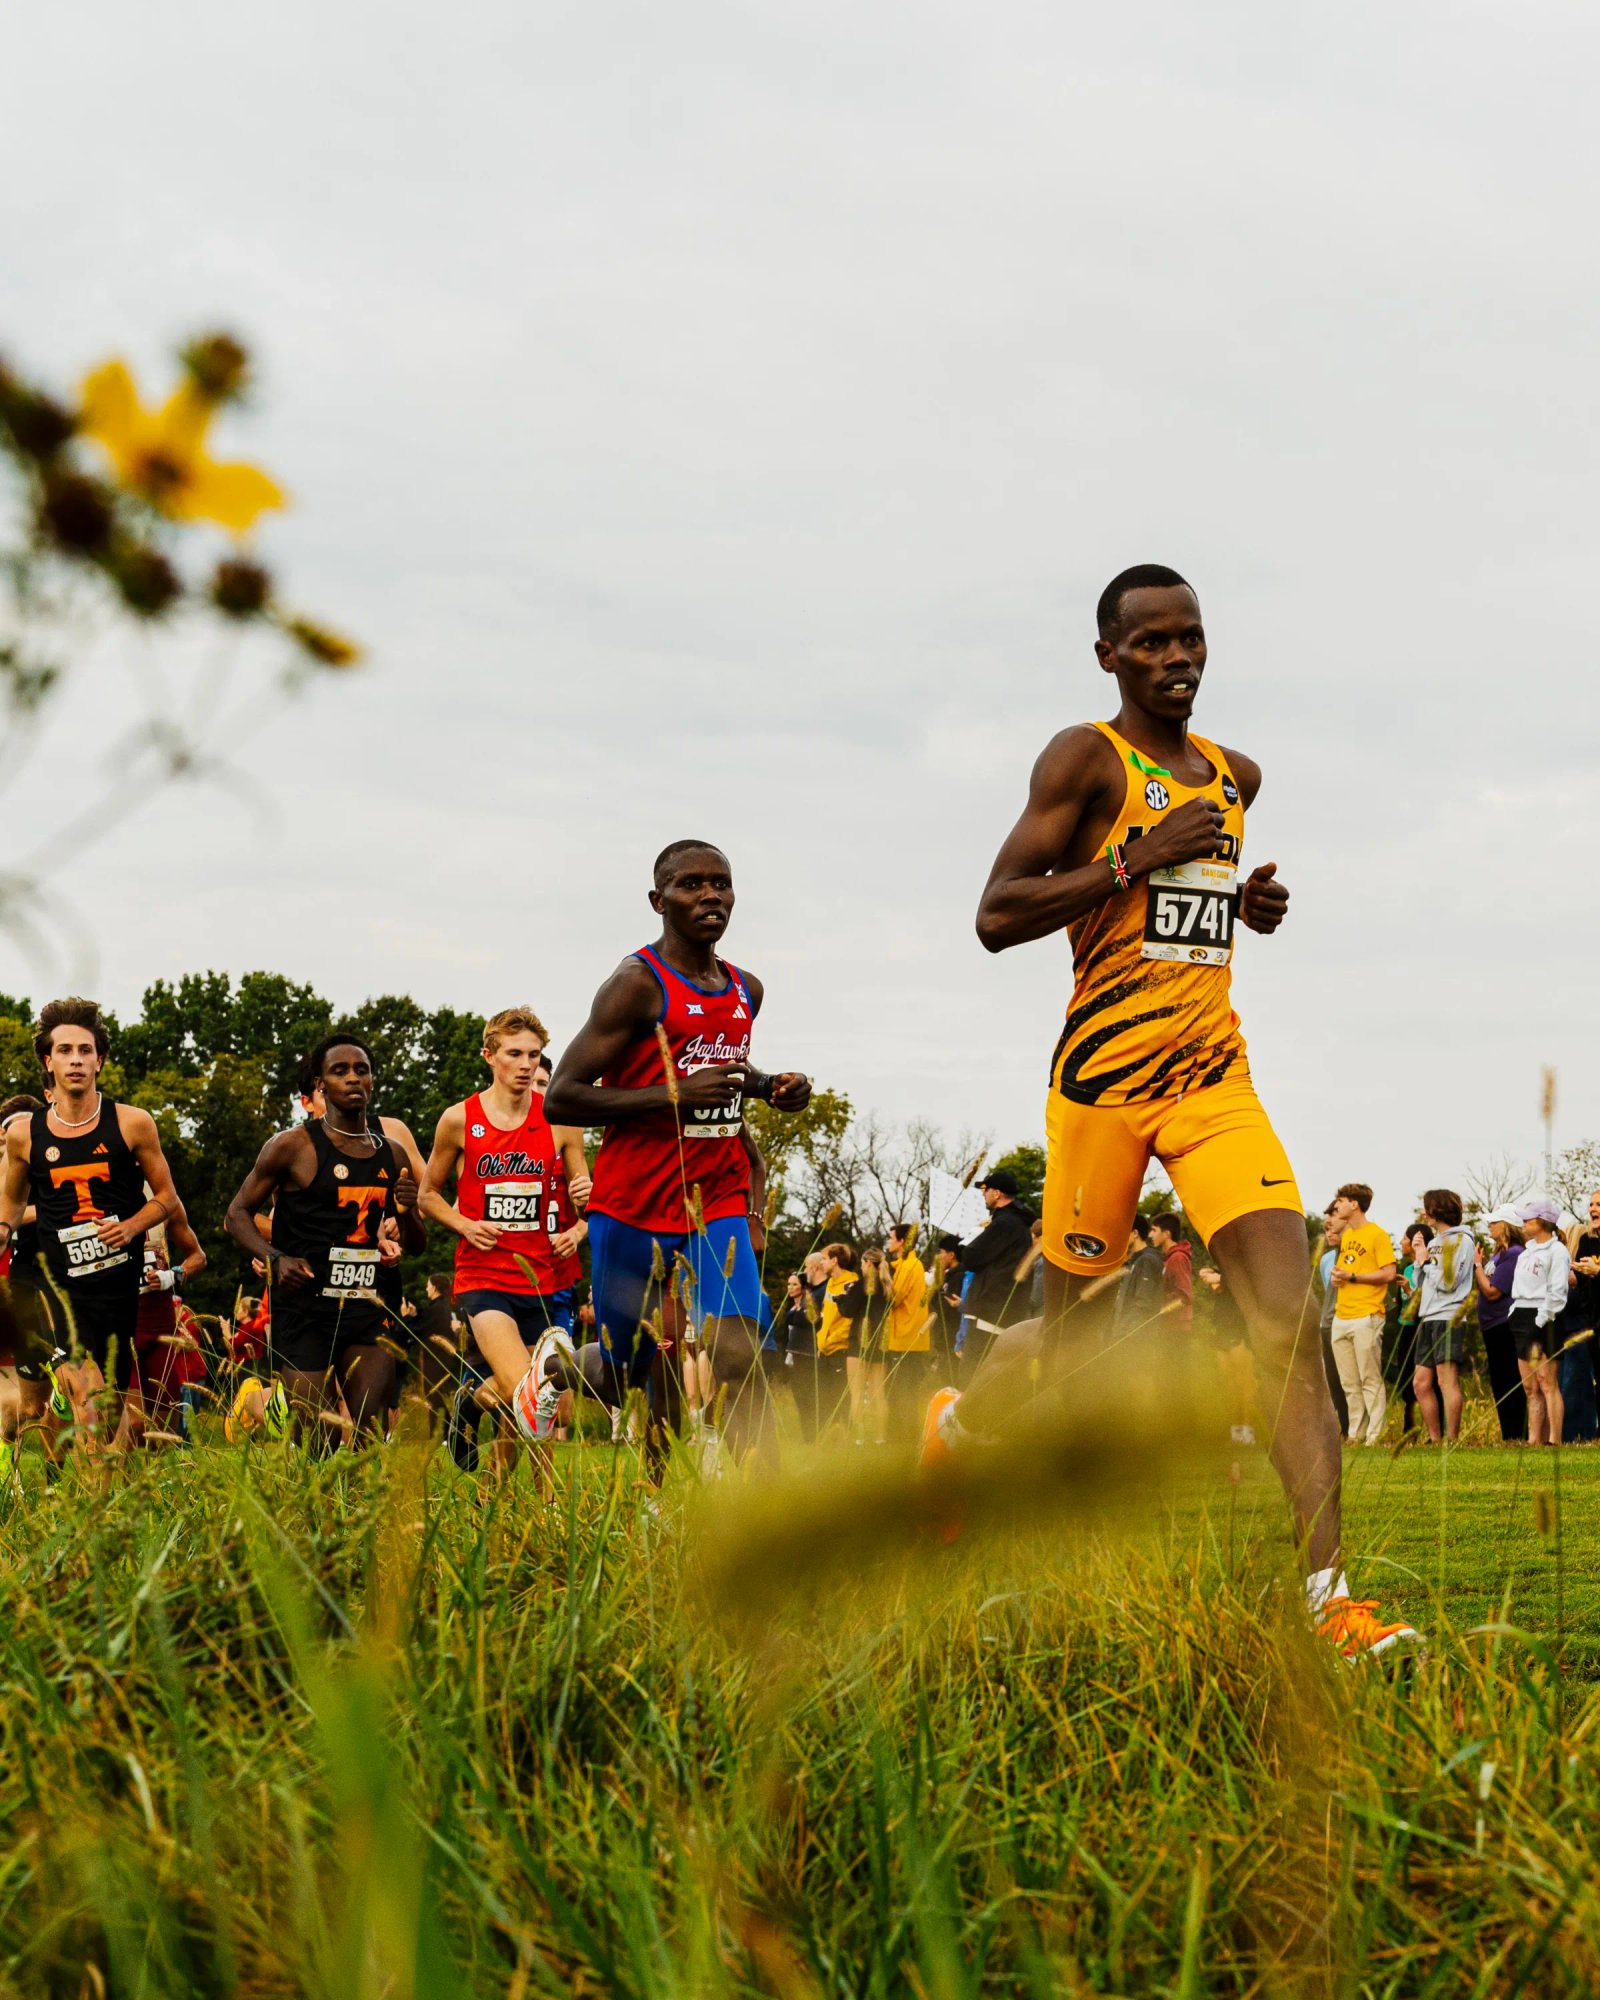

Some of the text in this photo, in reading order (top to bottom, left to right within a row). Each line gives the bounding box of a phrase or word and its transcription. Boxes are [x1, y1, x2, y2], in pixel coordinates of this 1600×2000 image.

[1145, 780, 1169, 810] SEC
[1155, 892, 1228, 941] 5741
[472, 1123, 486, 1138] SEC
[477, 1151, 544, 1178] Ole Miss
[50, 1161, 111, 1223] T
[337, 1186, 388, 1243] T
[488, 1197, 537, 1220] 5824
[66, 1235, 121, 1265] 595
[330, 1263, 376, 1287] 5949
